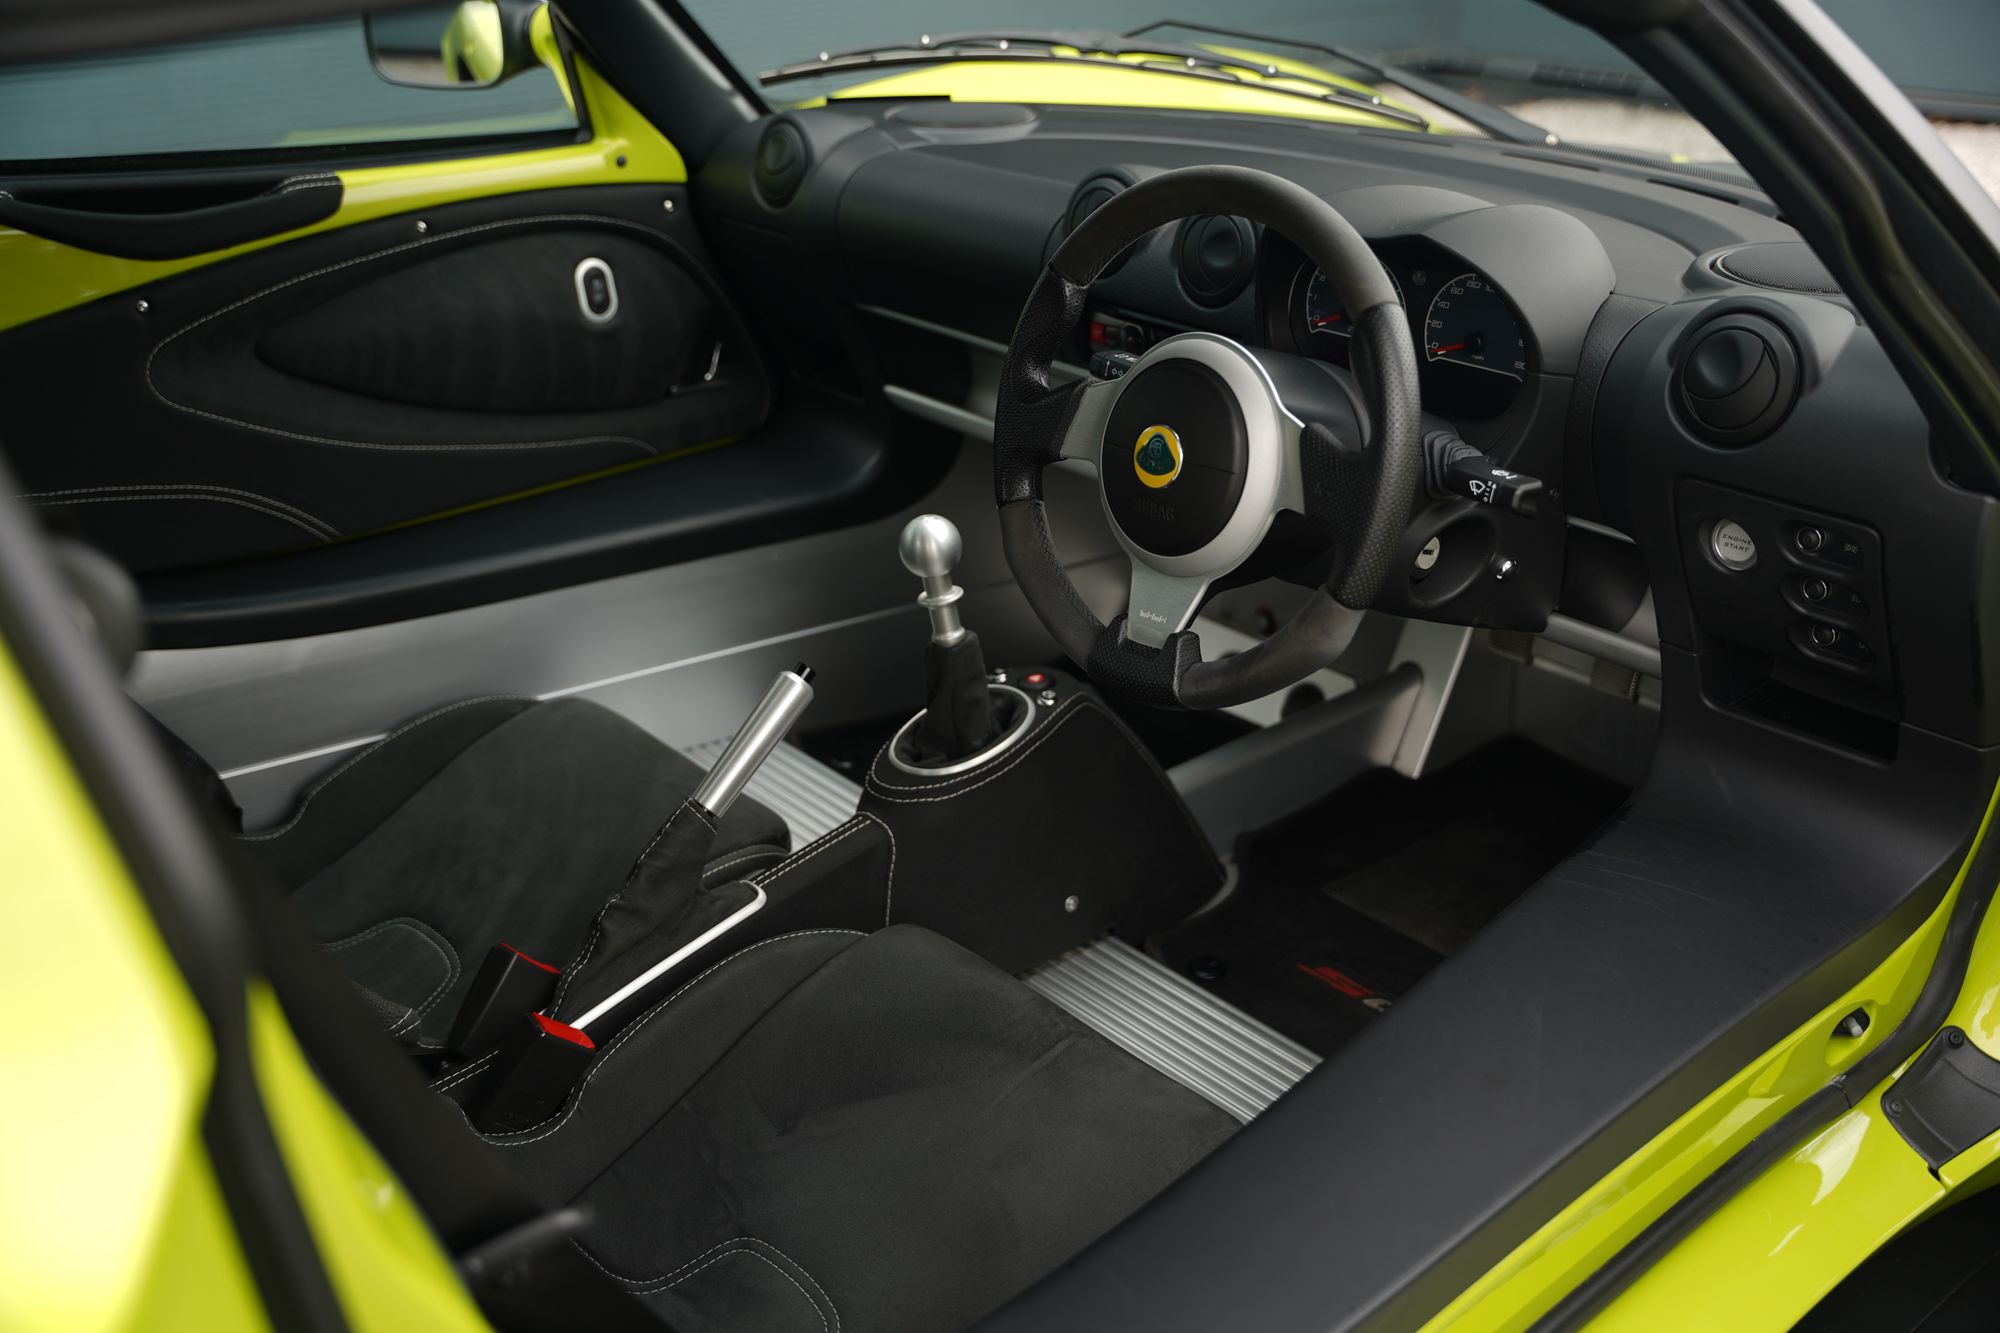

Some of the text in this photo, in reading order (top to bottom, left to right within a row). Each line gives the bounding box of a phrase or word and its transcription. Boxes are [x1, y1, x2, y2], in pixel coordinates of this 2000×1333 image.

[1466, 279, 1482, 289] 80
[1450, 286, 1464, 295] 60
[1437, 300, 1450, 309] 40
[1431, 319, 1442, 328] 20
[1431, 341, 1439, 349] 0
[1132, 497, 1175, 522] AIRBAG
[1722, 534, 1752, 546] ENGINE
[1724, 542, 1749, 552] START
